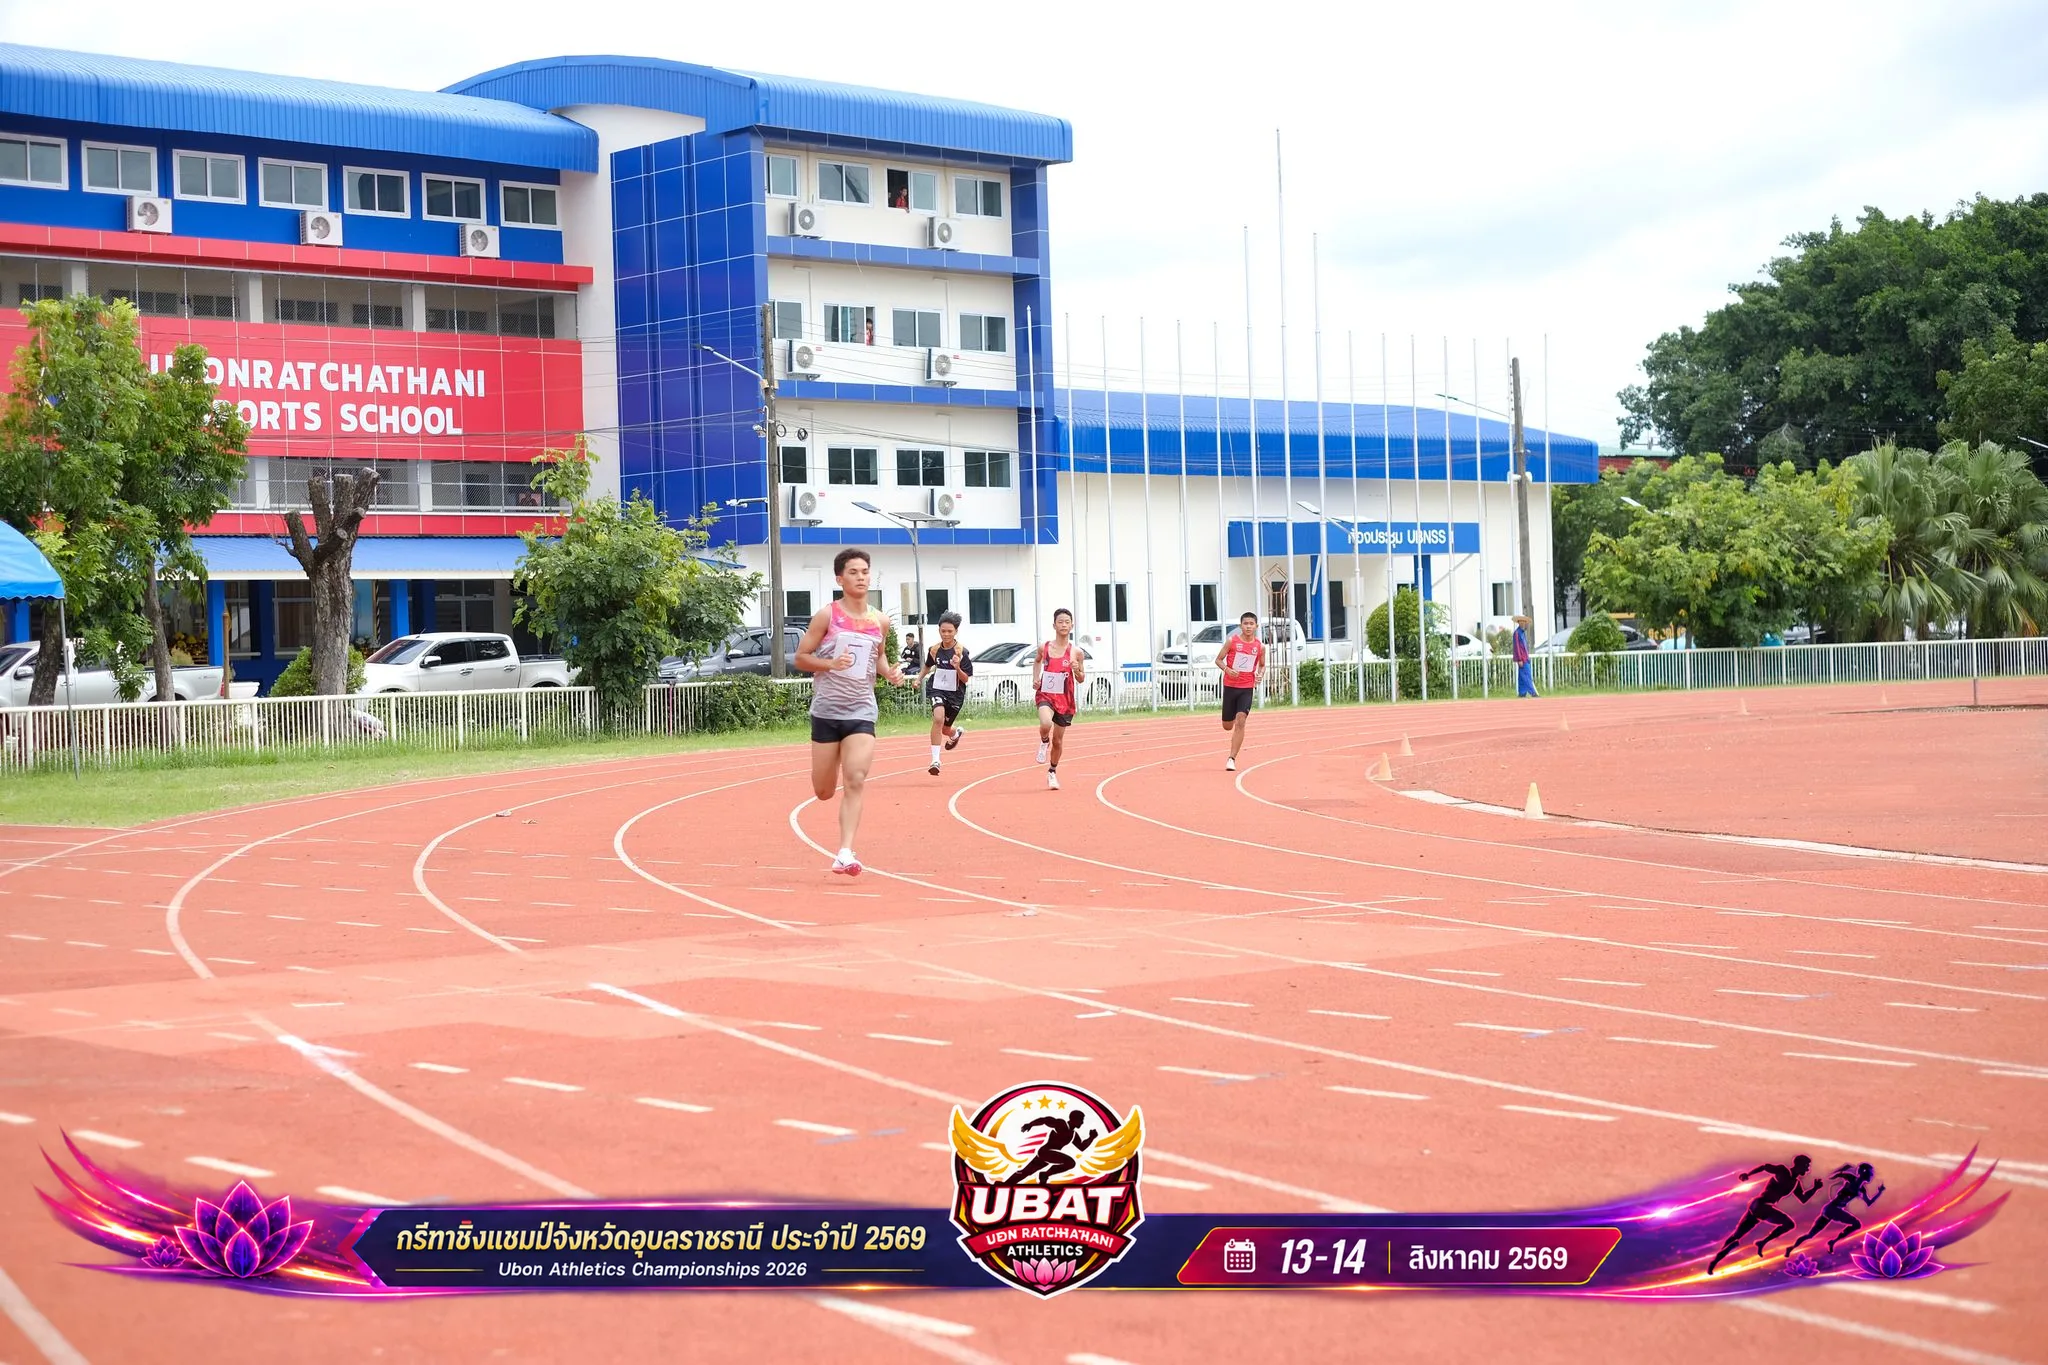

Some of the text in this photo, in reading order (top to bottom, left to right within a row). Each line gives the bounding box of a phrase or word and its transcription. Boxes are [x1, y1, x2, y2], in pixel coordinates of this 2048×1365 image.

[150, 353, 485, 398] UONRATCHATHANI
[340, 401, 463, 435] SCHOOL
[1407, 529, 1447, 544] UBNSS
[1238, 656, 1248, 669] 2
[1046, 676, 1055, 689] 3
